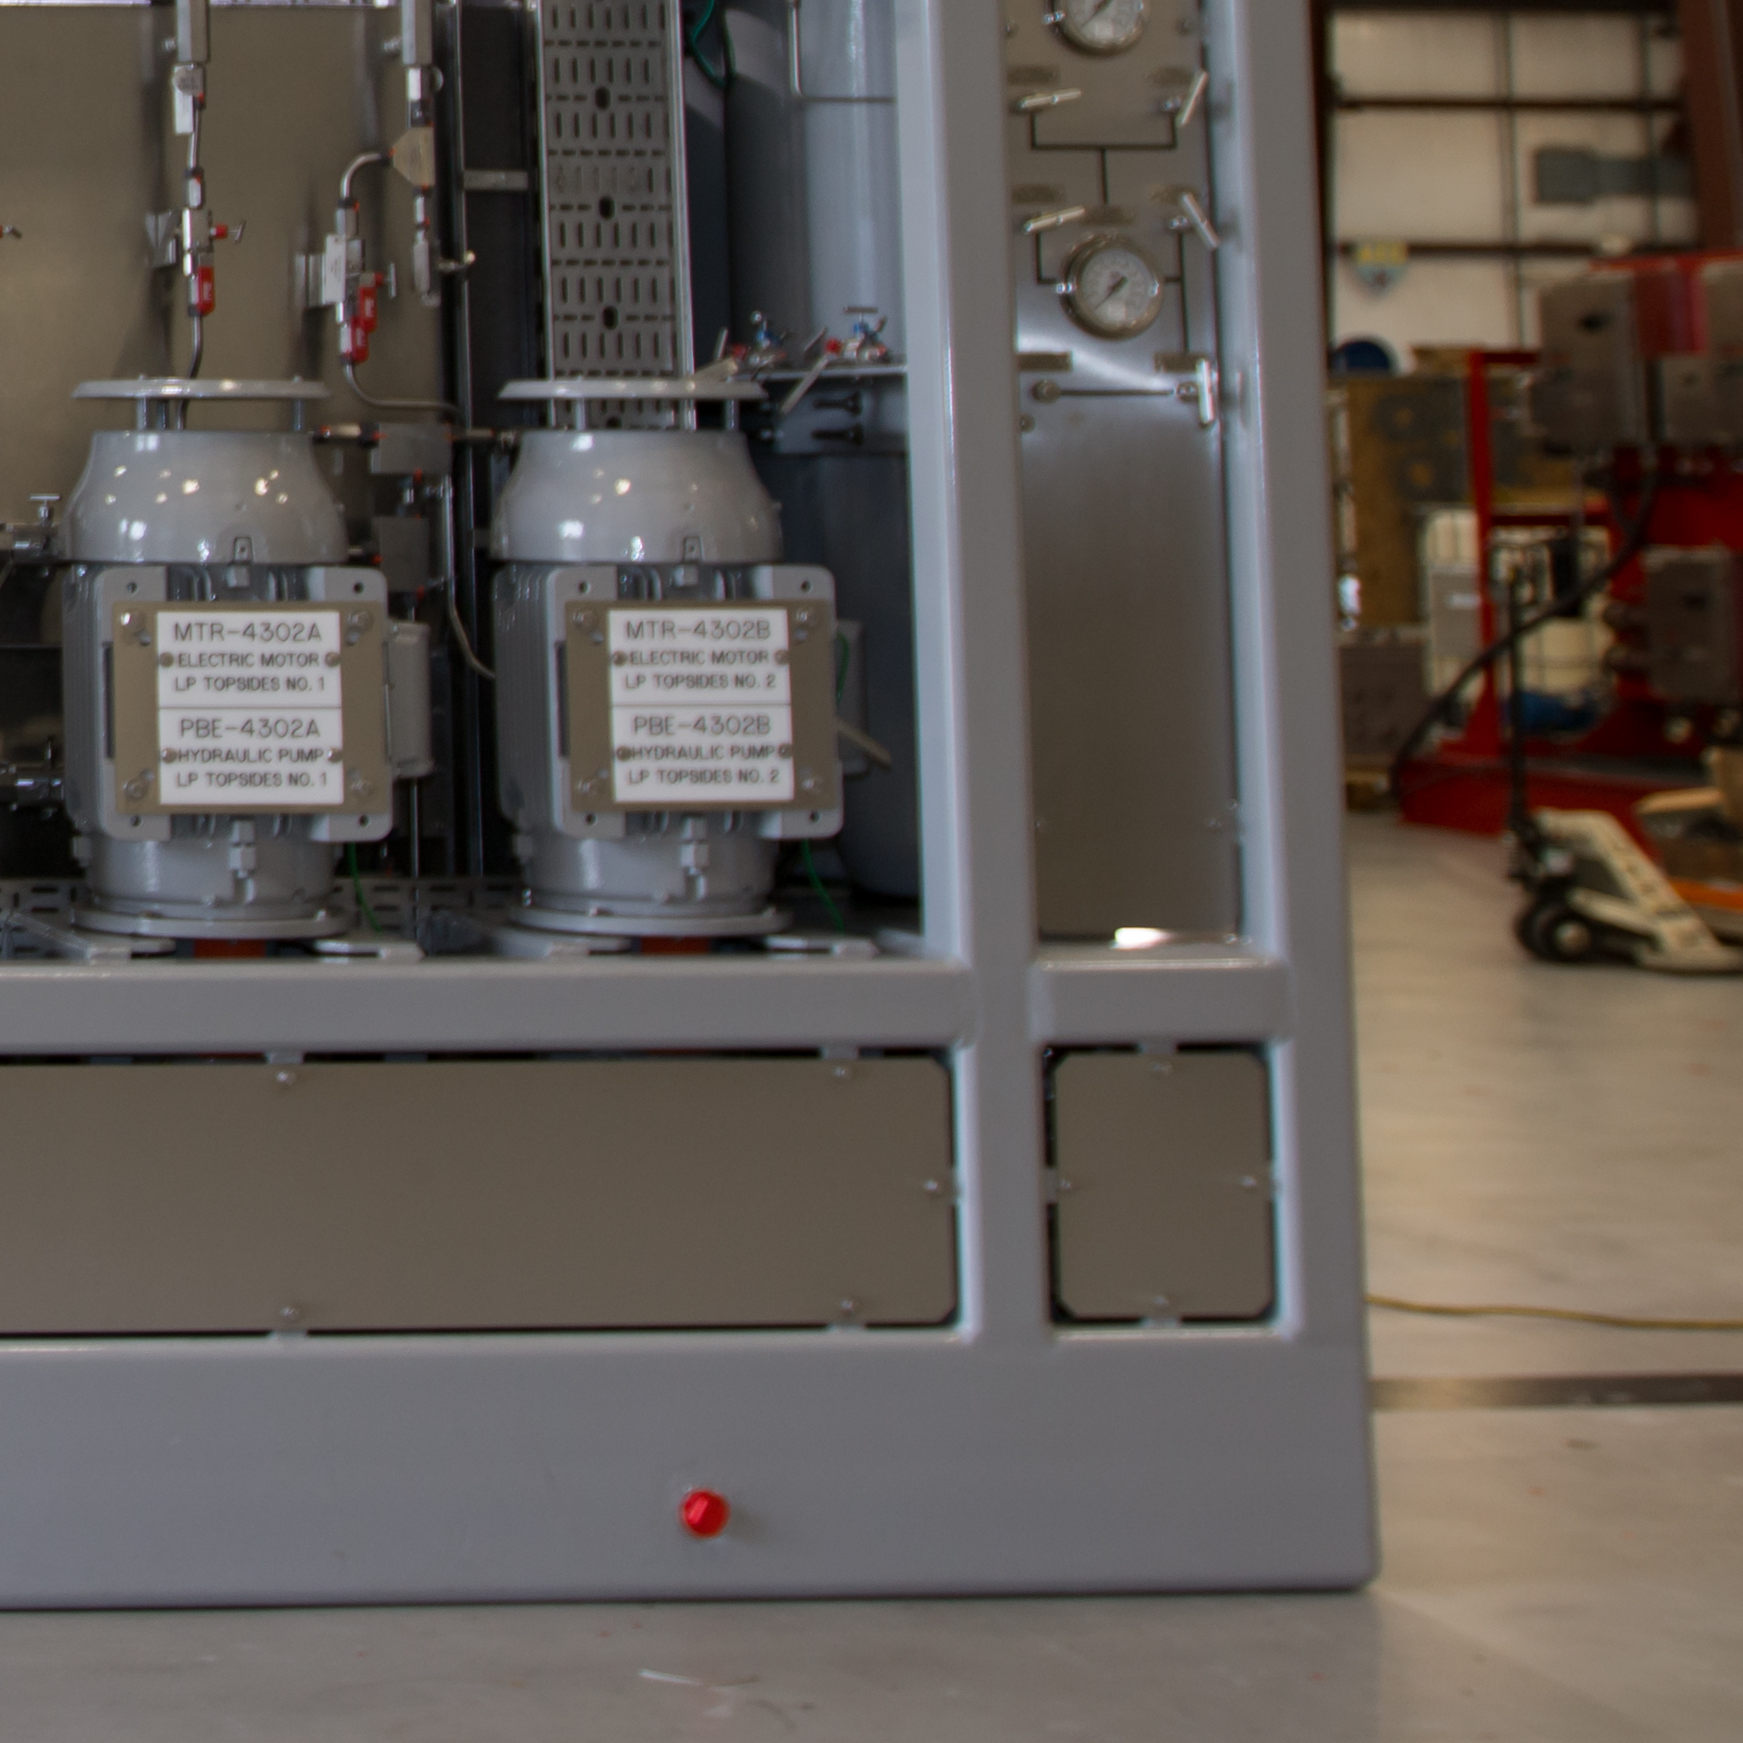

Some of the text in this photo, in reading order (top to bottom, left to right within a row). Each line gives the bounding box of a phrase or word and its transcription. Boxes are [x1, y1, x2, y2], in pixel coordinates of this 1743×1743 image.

[173, 621, 322, 643] MTR-4302A
[625, 619, 771, 641] MTR-4302B
[176, 652, 319, 668] ELECTRIC MOTOR
[628, 649, 769, 666] ELECTRIC MOTOR
[174, 676, 325, 692] LP TOPSIDES NO. 1
[625, 673, 776, 690] LP TOPSIDES NO. 2
[179, 718, 320, 739] PBE-4302A
[633, 714, 771, 736] PBE-4302B
[177, 748, 324, 764] HYDRAULIC PUMP
[630, 744, 776, 761] HYDRAULIC PUMP
[176, 771, 327, 788] LP TOPSIDES NO. 1
[628, 768, 780, 785] LP TOPSIDES NO. 2
